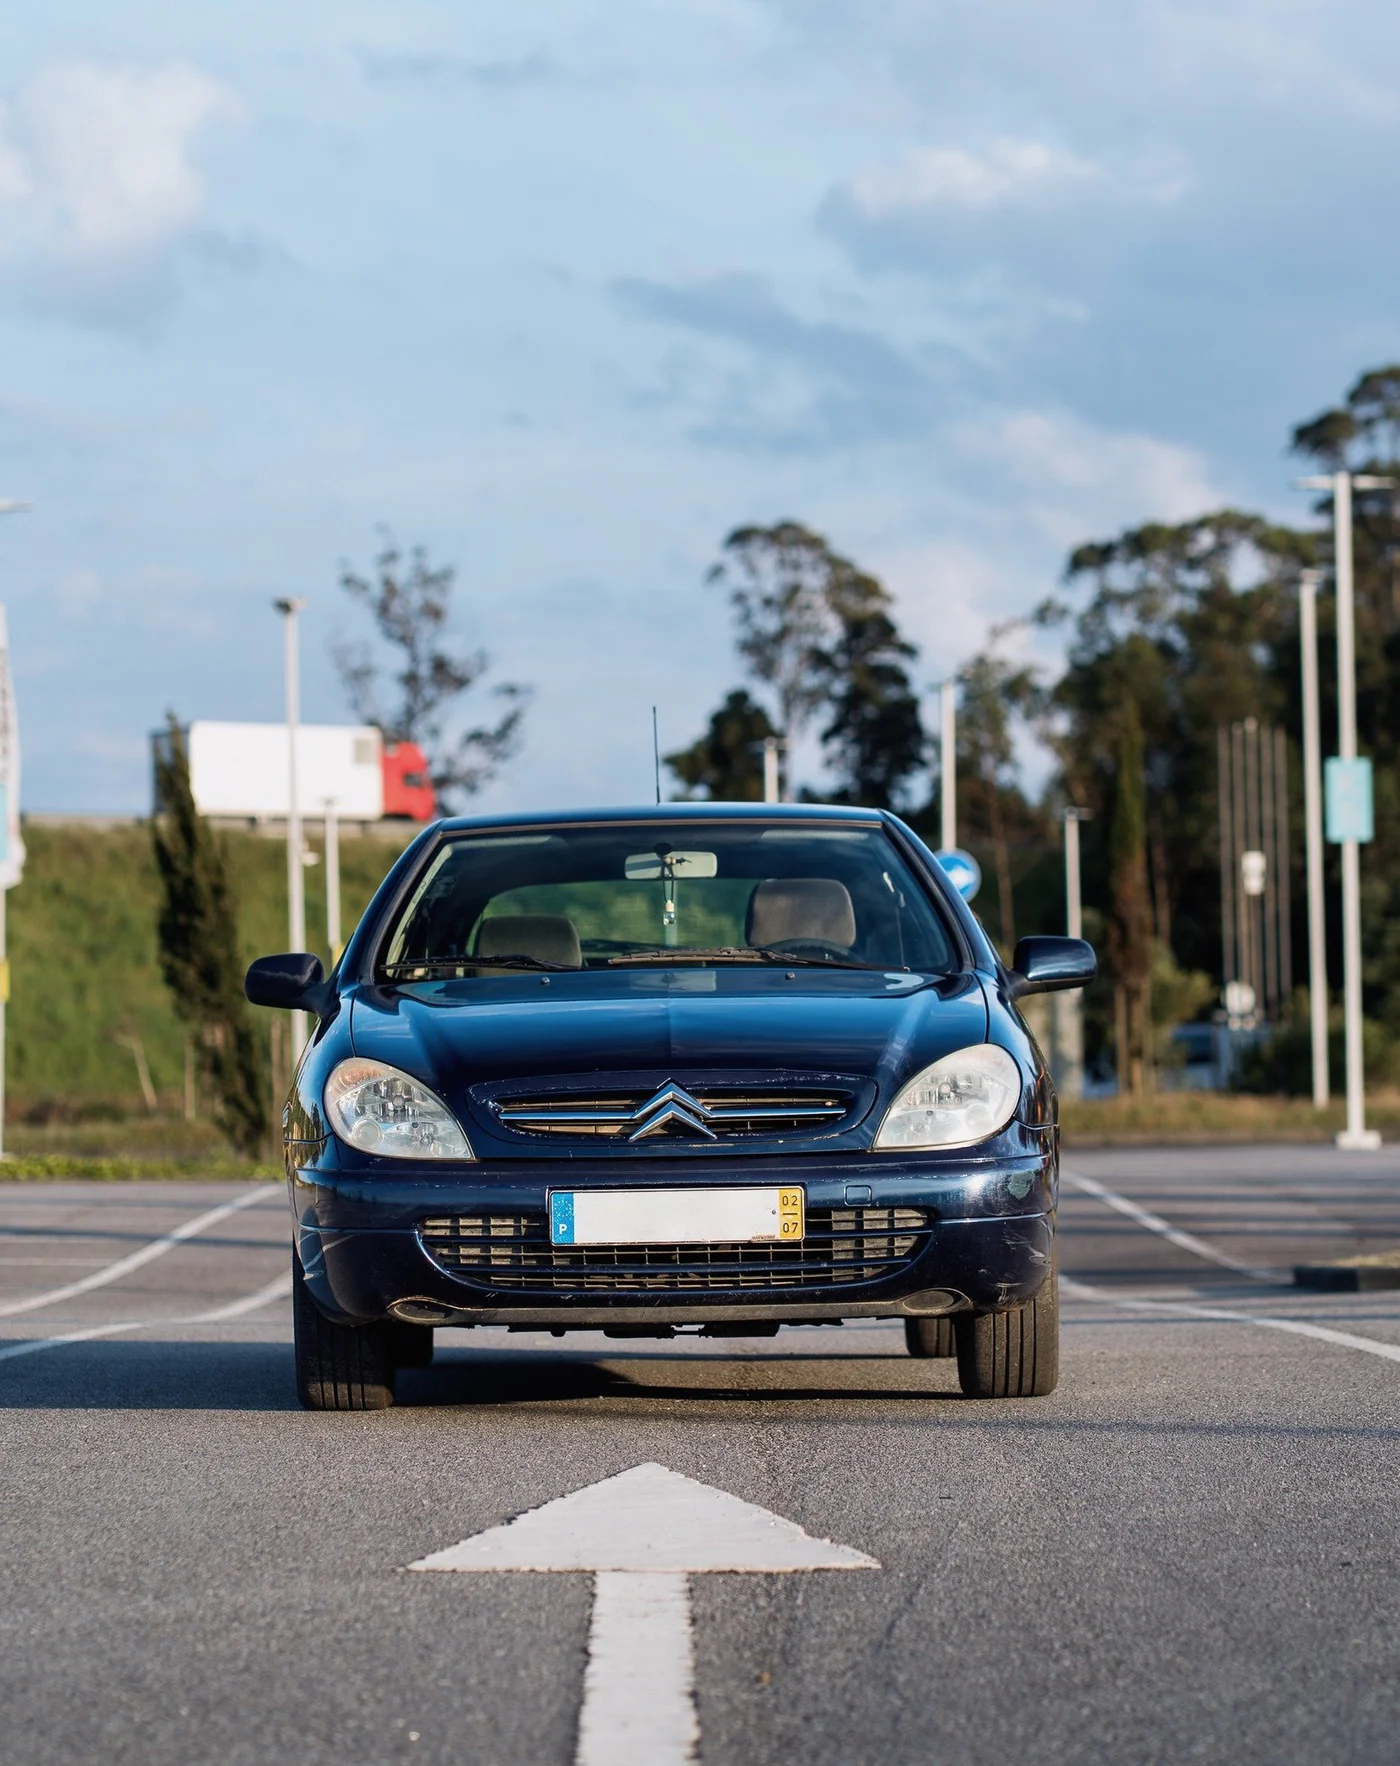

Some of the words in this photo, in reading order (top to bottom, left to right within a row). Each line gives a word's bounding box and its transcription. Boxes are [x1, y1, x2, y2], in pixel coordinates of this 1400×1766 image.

[782, 1195, 798, 1206] 02
[559, 1223, 568, 1235] P
[782, 1222, 799, 1233] 07
